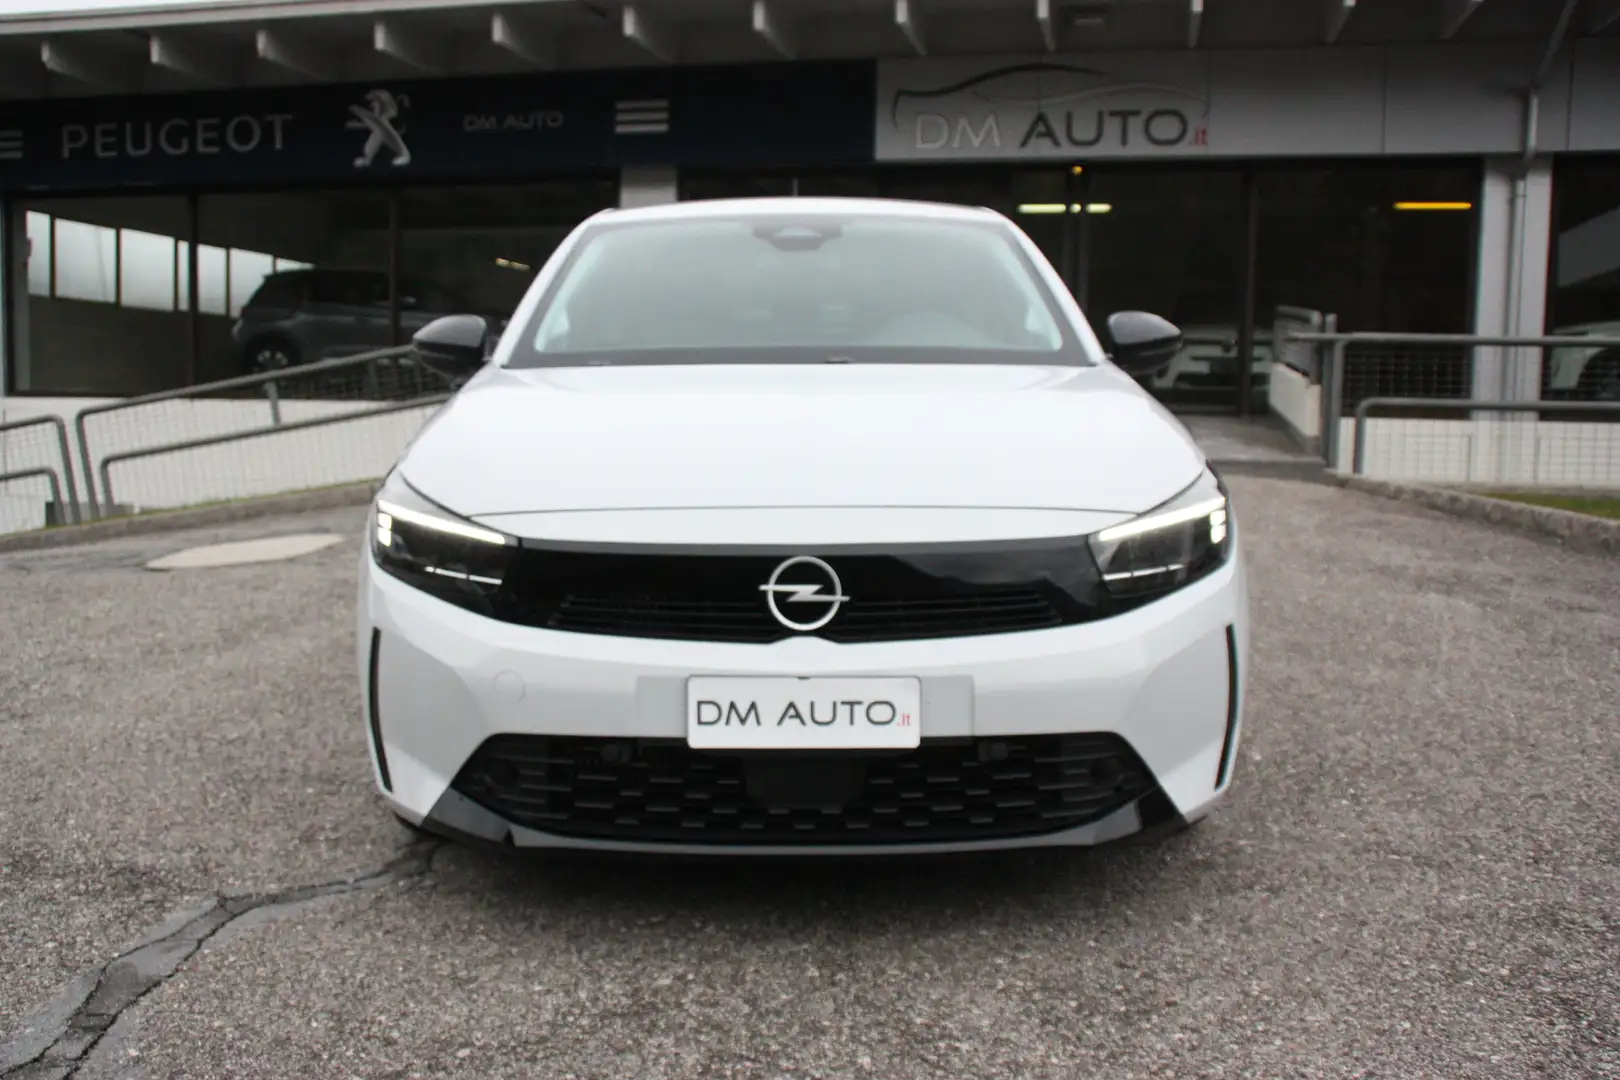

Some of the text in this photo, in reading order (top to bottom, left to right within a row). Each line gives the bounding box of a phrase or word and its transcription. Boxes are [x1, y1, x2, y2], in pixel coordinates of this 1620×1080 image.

[60, 114, 294, 159] PEUGEOT
[463, 110, 564, 131] DM AUTO
[915, 108, 1208, 148] DM AUTO.it
[696, 700, 911, 727] DM AUTO.it
